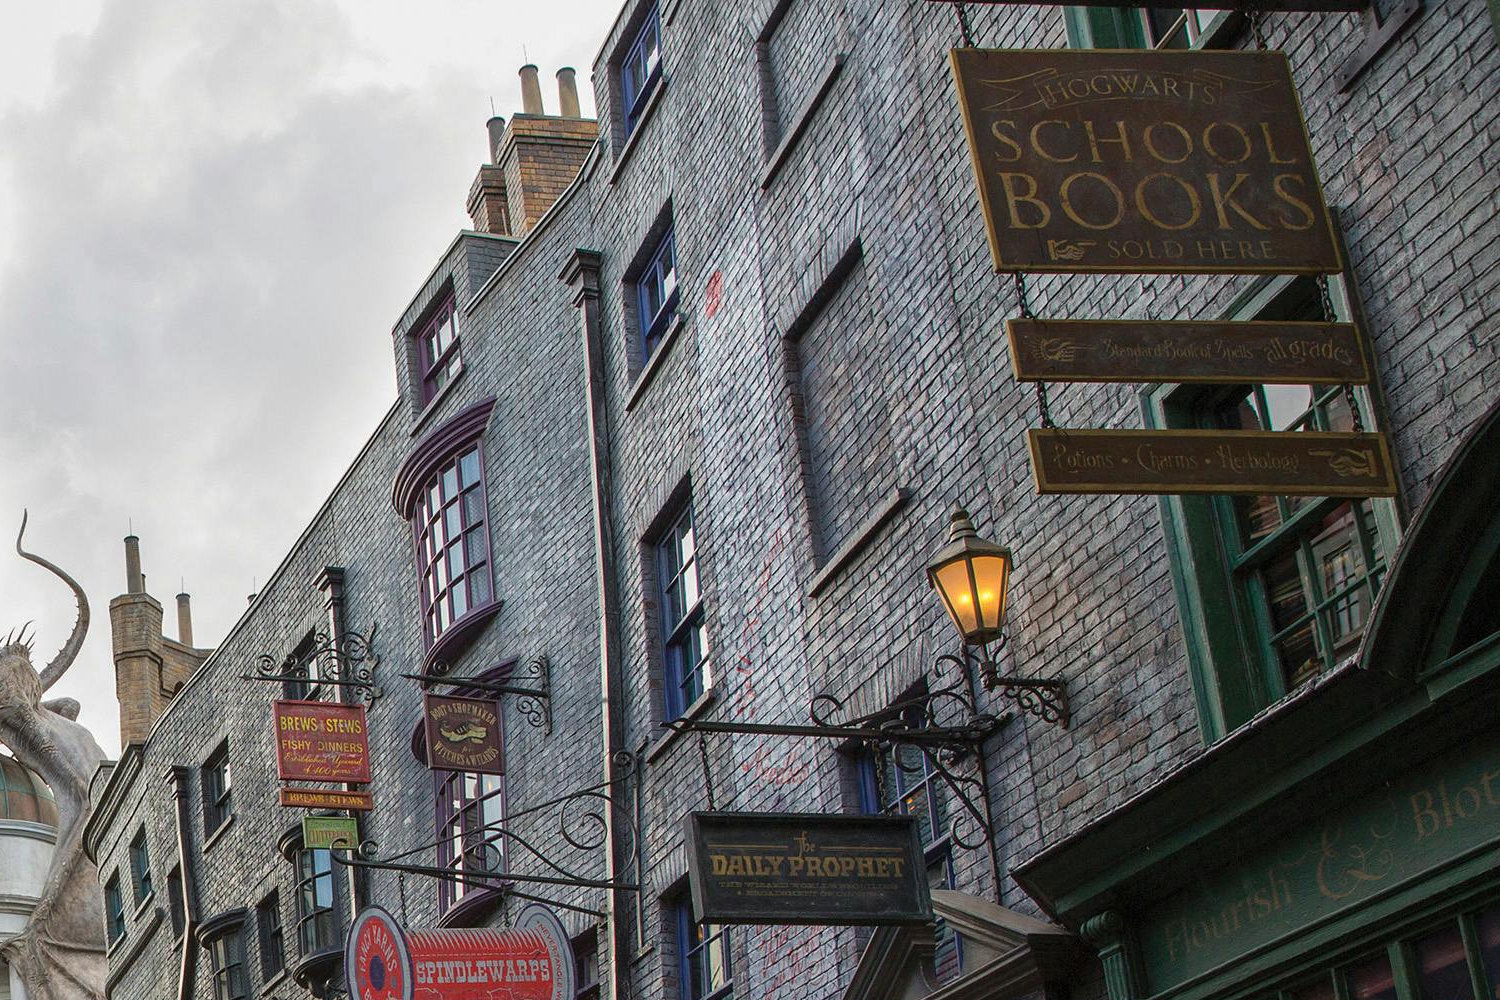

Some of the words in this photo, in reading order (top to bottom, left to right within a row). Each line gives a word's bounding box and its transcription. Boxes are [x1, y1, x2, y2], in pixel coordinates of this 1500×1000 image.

[1043, 74, 1215, 105] HOGWARTS
[990, 119, 1298, 165] SCHOOL
[997, 171, 1316, 231] BOOKS
[1107, 240, 1184, 260] SOLD
[1198, 239, 1278, 260] HERE
[1053, 443, 1114, 474] Potions
[1137, 443, 1198, 475] Charms
[1216, 443, 1299, 475] Herbology
[280, 715, 318, 733] BREWS
[326, 717, 362, 734] STEWS
[429, 704, 447, 721] BOOT
[452, 703, 496, 726] SHOEMAKER
[281, 739, 311, 751] FISHY
[318, 741, 364, 754] DINNERS
[433, 740, 465, 766] WITCHES
[470, 745, 499, 767] WIZARDS
[290, 793, 324, 804] BREWS
[329, 794, 364, 806] STEWS
[710, 855, 784, 877] DAILY
[787, 855, 905, 878] PROPHET
[360, 928, 372, 973] FANCY
[372, 924, 398, 973] YARNS
[416, 959, 550, 984] SPINDLEWARPS
